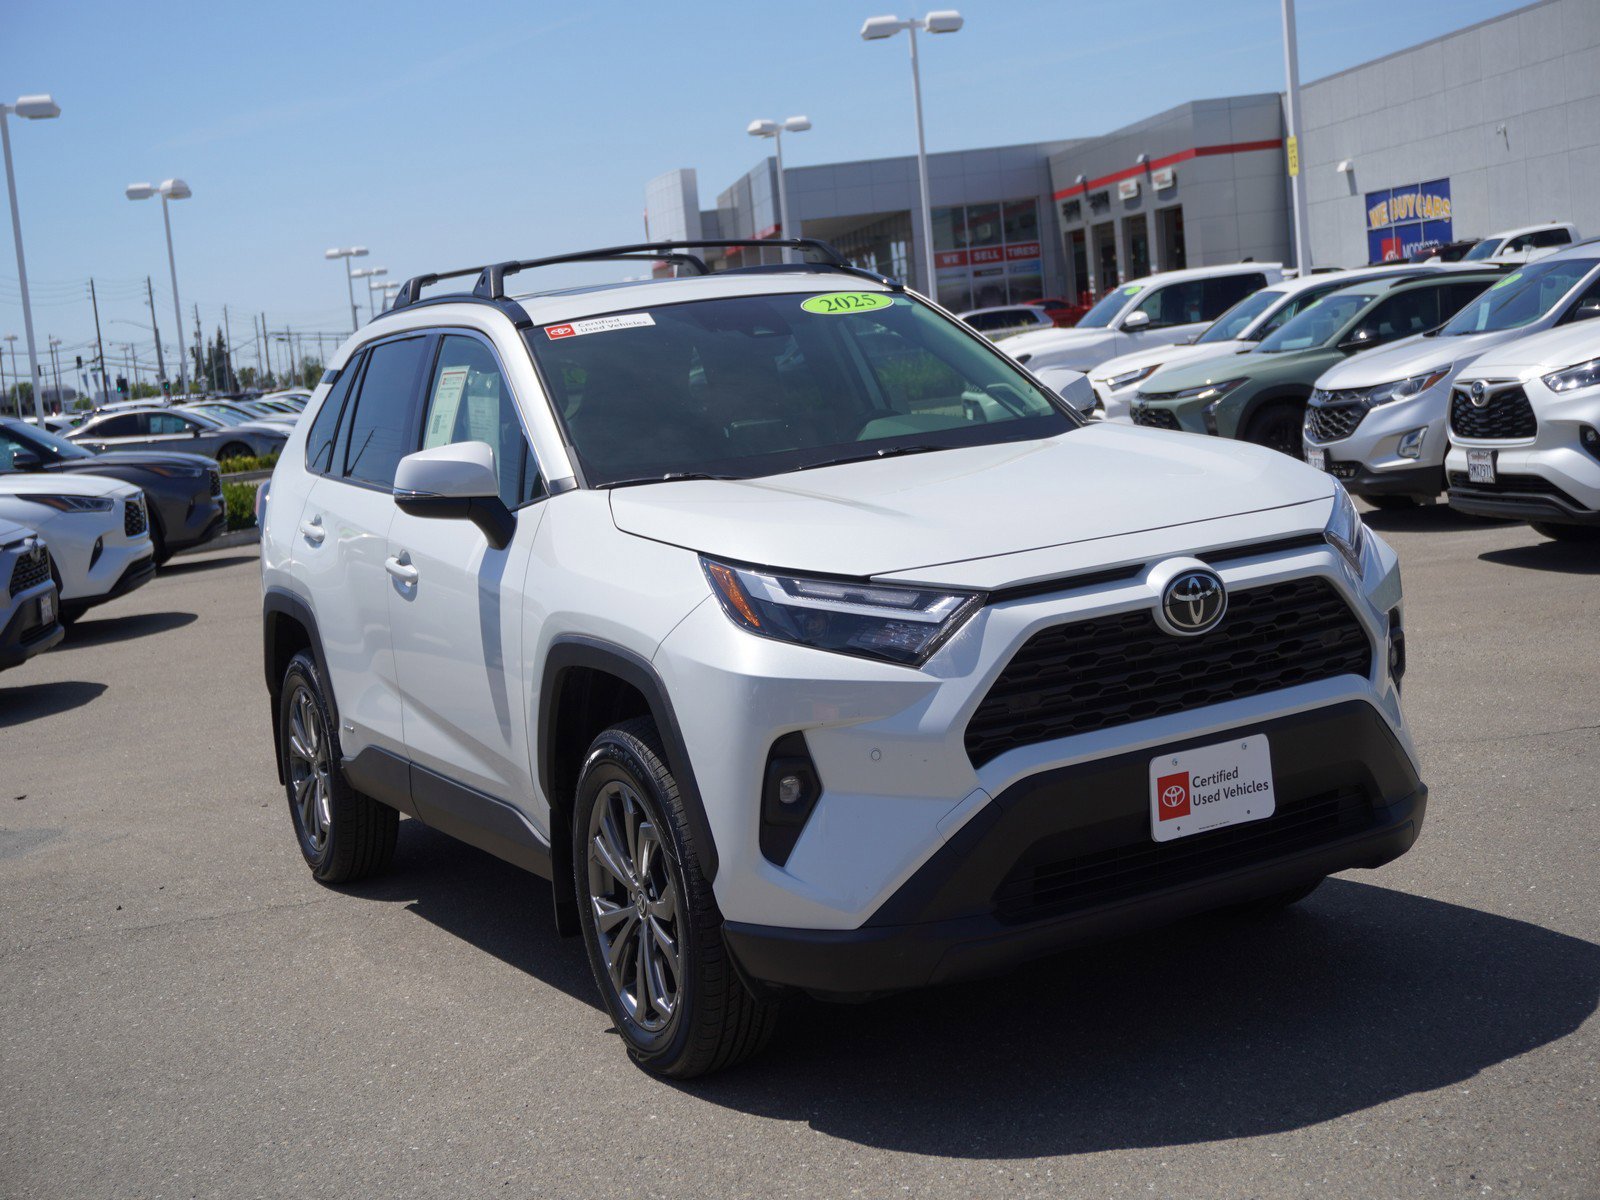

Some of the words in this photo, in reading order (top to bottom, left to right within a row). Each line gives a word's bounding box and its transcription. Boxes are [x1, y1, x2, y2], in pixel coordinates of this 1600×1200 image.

[1369, 201, 1389, 229] WE
[1389, 193, 1416, 222] BUY
[1415, 193, 1451, 223] CARS
[974, 250, 999, 261] SELL
[819, 294, 877, 312] 2025
[578, 318, 620, 328] Certified
[581, 325, 606, 333] Used
[609, 319, 648, 329] Vehicles
[1192, 766, 1239, 788] Certified
[1193, 788, 1220, 806] Used
[1223, 780, 1269, 799] Vehicles
